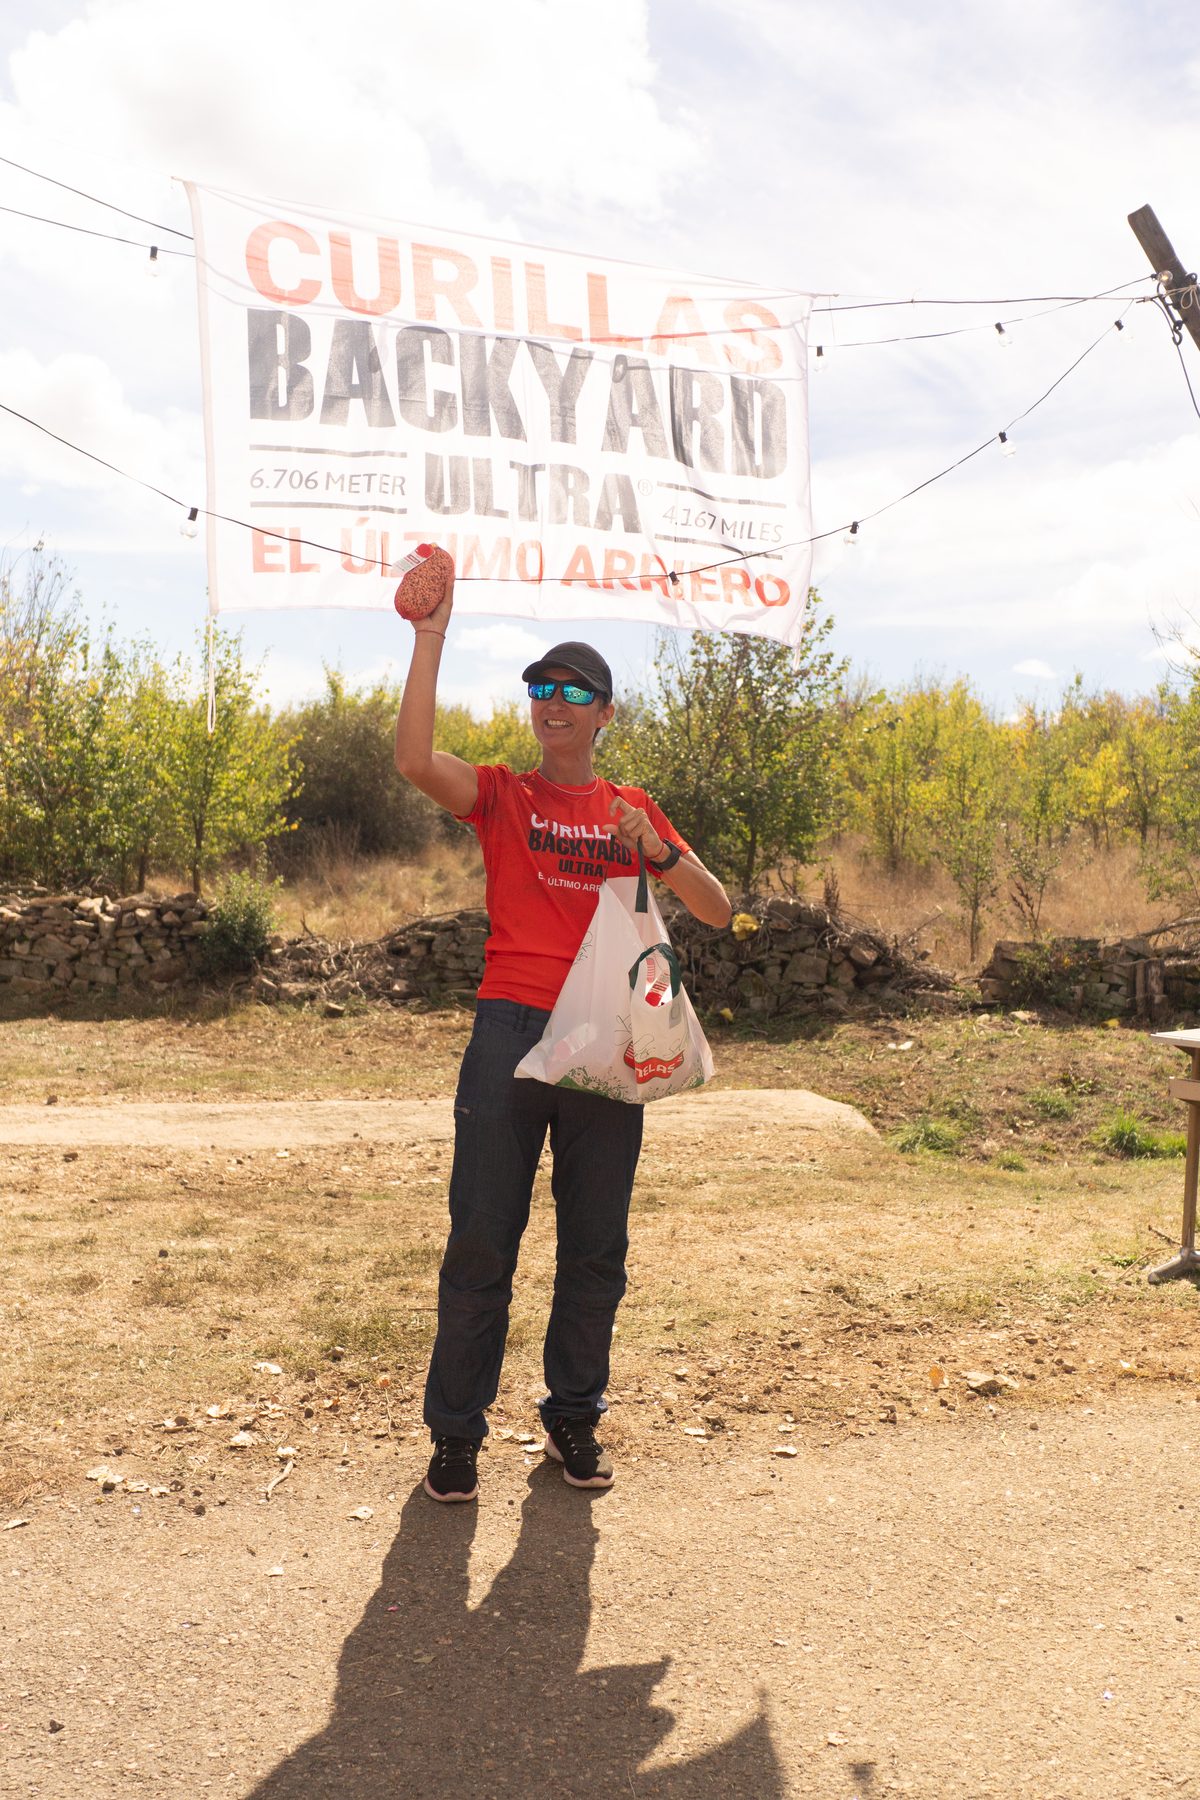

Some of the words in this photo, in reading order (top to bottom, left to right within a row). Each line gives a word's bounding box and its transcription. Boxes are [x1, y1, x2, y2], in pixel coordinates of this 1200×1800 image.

[245, 221, 784, 374] CURILLAS
[246, 308, 788, 480] BACKYARD
[249, 468, 318, 491] 6.706
[325, 471, 407, 496] METER
[662, 505, 717, 531] 4.167
[721, 519, 783, 544] MILES
[252, 526, 321, 574] EL
[560, 544, 790, 606] ARRIERO
[528, 829, 632, 866] BACKYARD
[547, 876, 581, 890] ÚLTIMO
[558, 858, 603, 877] ULTRA
